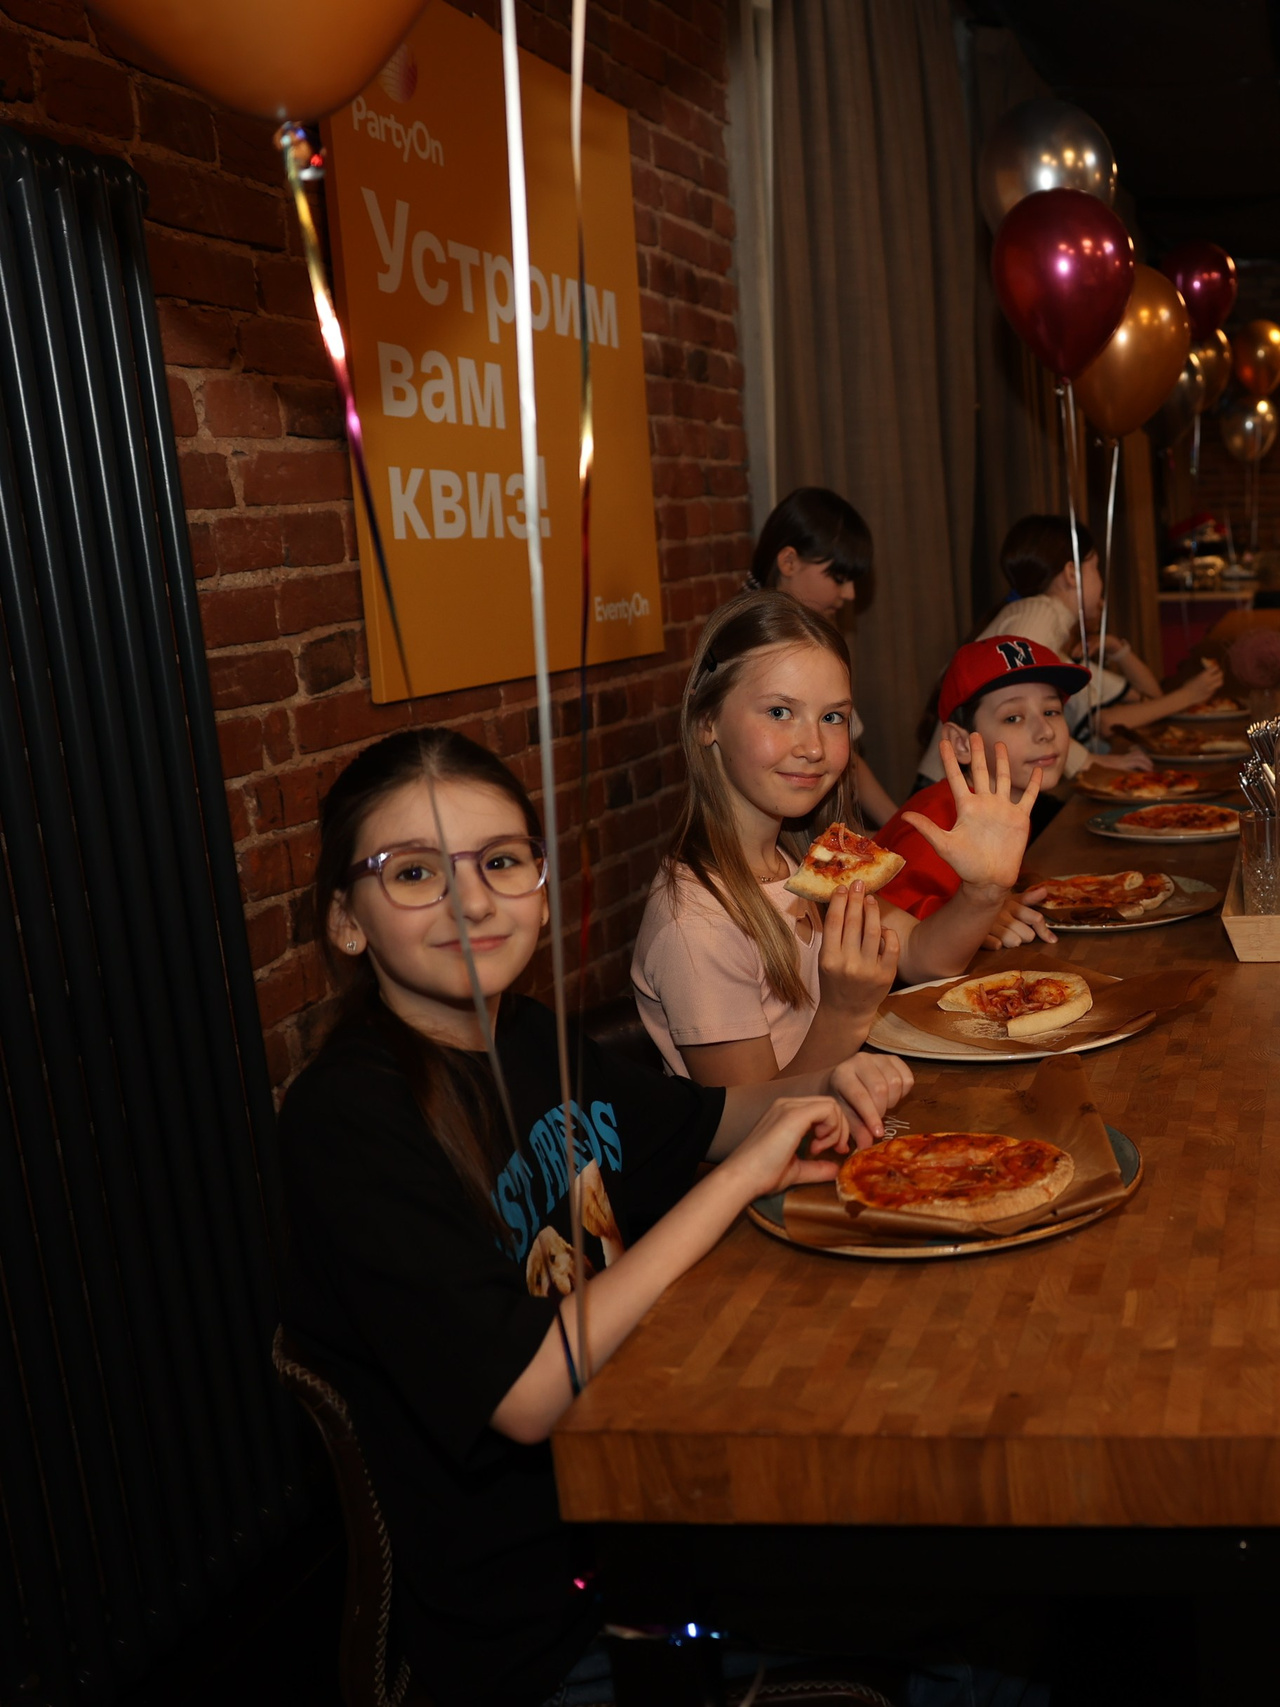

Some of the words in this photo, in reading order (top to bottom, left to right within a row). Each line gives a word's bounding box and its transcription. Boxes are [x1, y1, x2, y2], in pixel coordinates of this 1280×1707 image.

[351, 95, 445, 167] PartyOn
[377, 341, 506, 430] вам
[594, 592, 650, 626] EventyOn
[996, 641, 1037, 671] N
